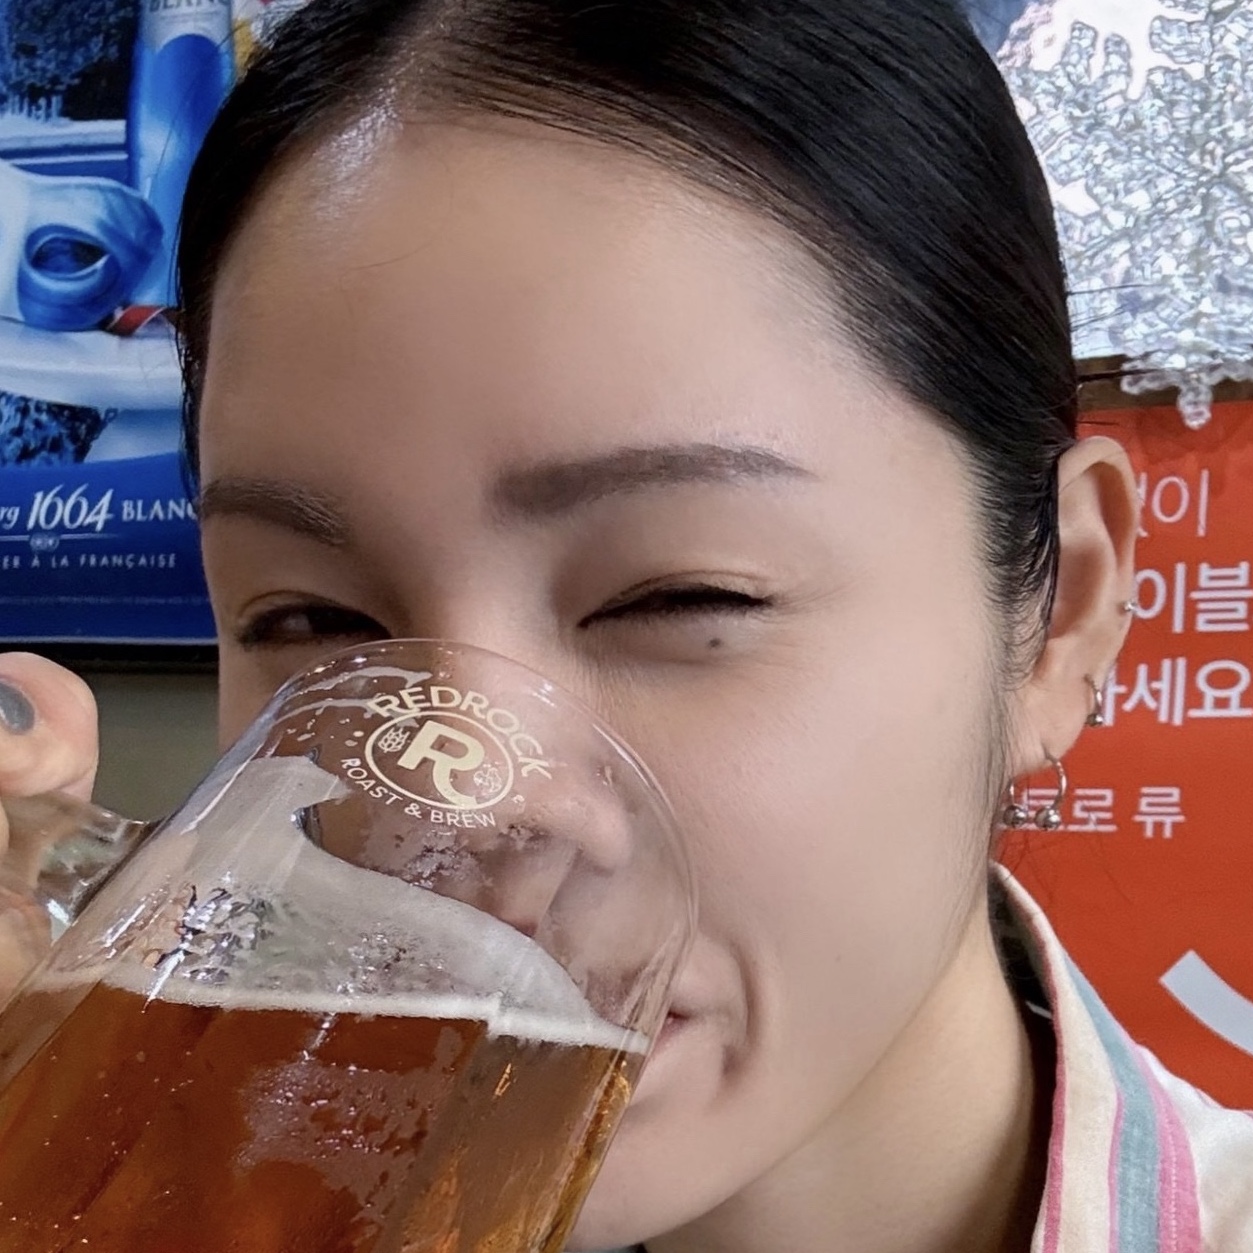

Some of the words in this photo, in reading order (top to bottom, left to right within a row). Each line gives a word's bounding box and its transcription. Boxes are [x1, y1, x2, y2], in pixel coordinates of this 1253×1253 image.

[27, 483, 115, 532] 1664
[366, 685, 553, 780] REDROCK
[397, 719, 486, 807] R
[340, 757, 404, 806] ROAST
[404, 803, 423, 820] &
[430, 809, 497, 829] BREW
[1132, 785, 1187, 840] 류
